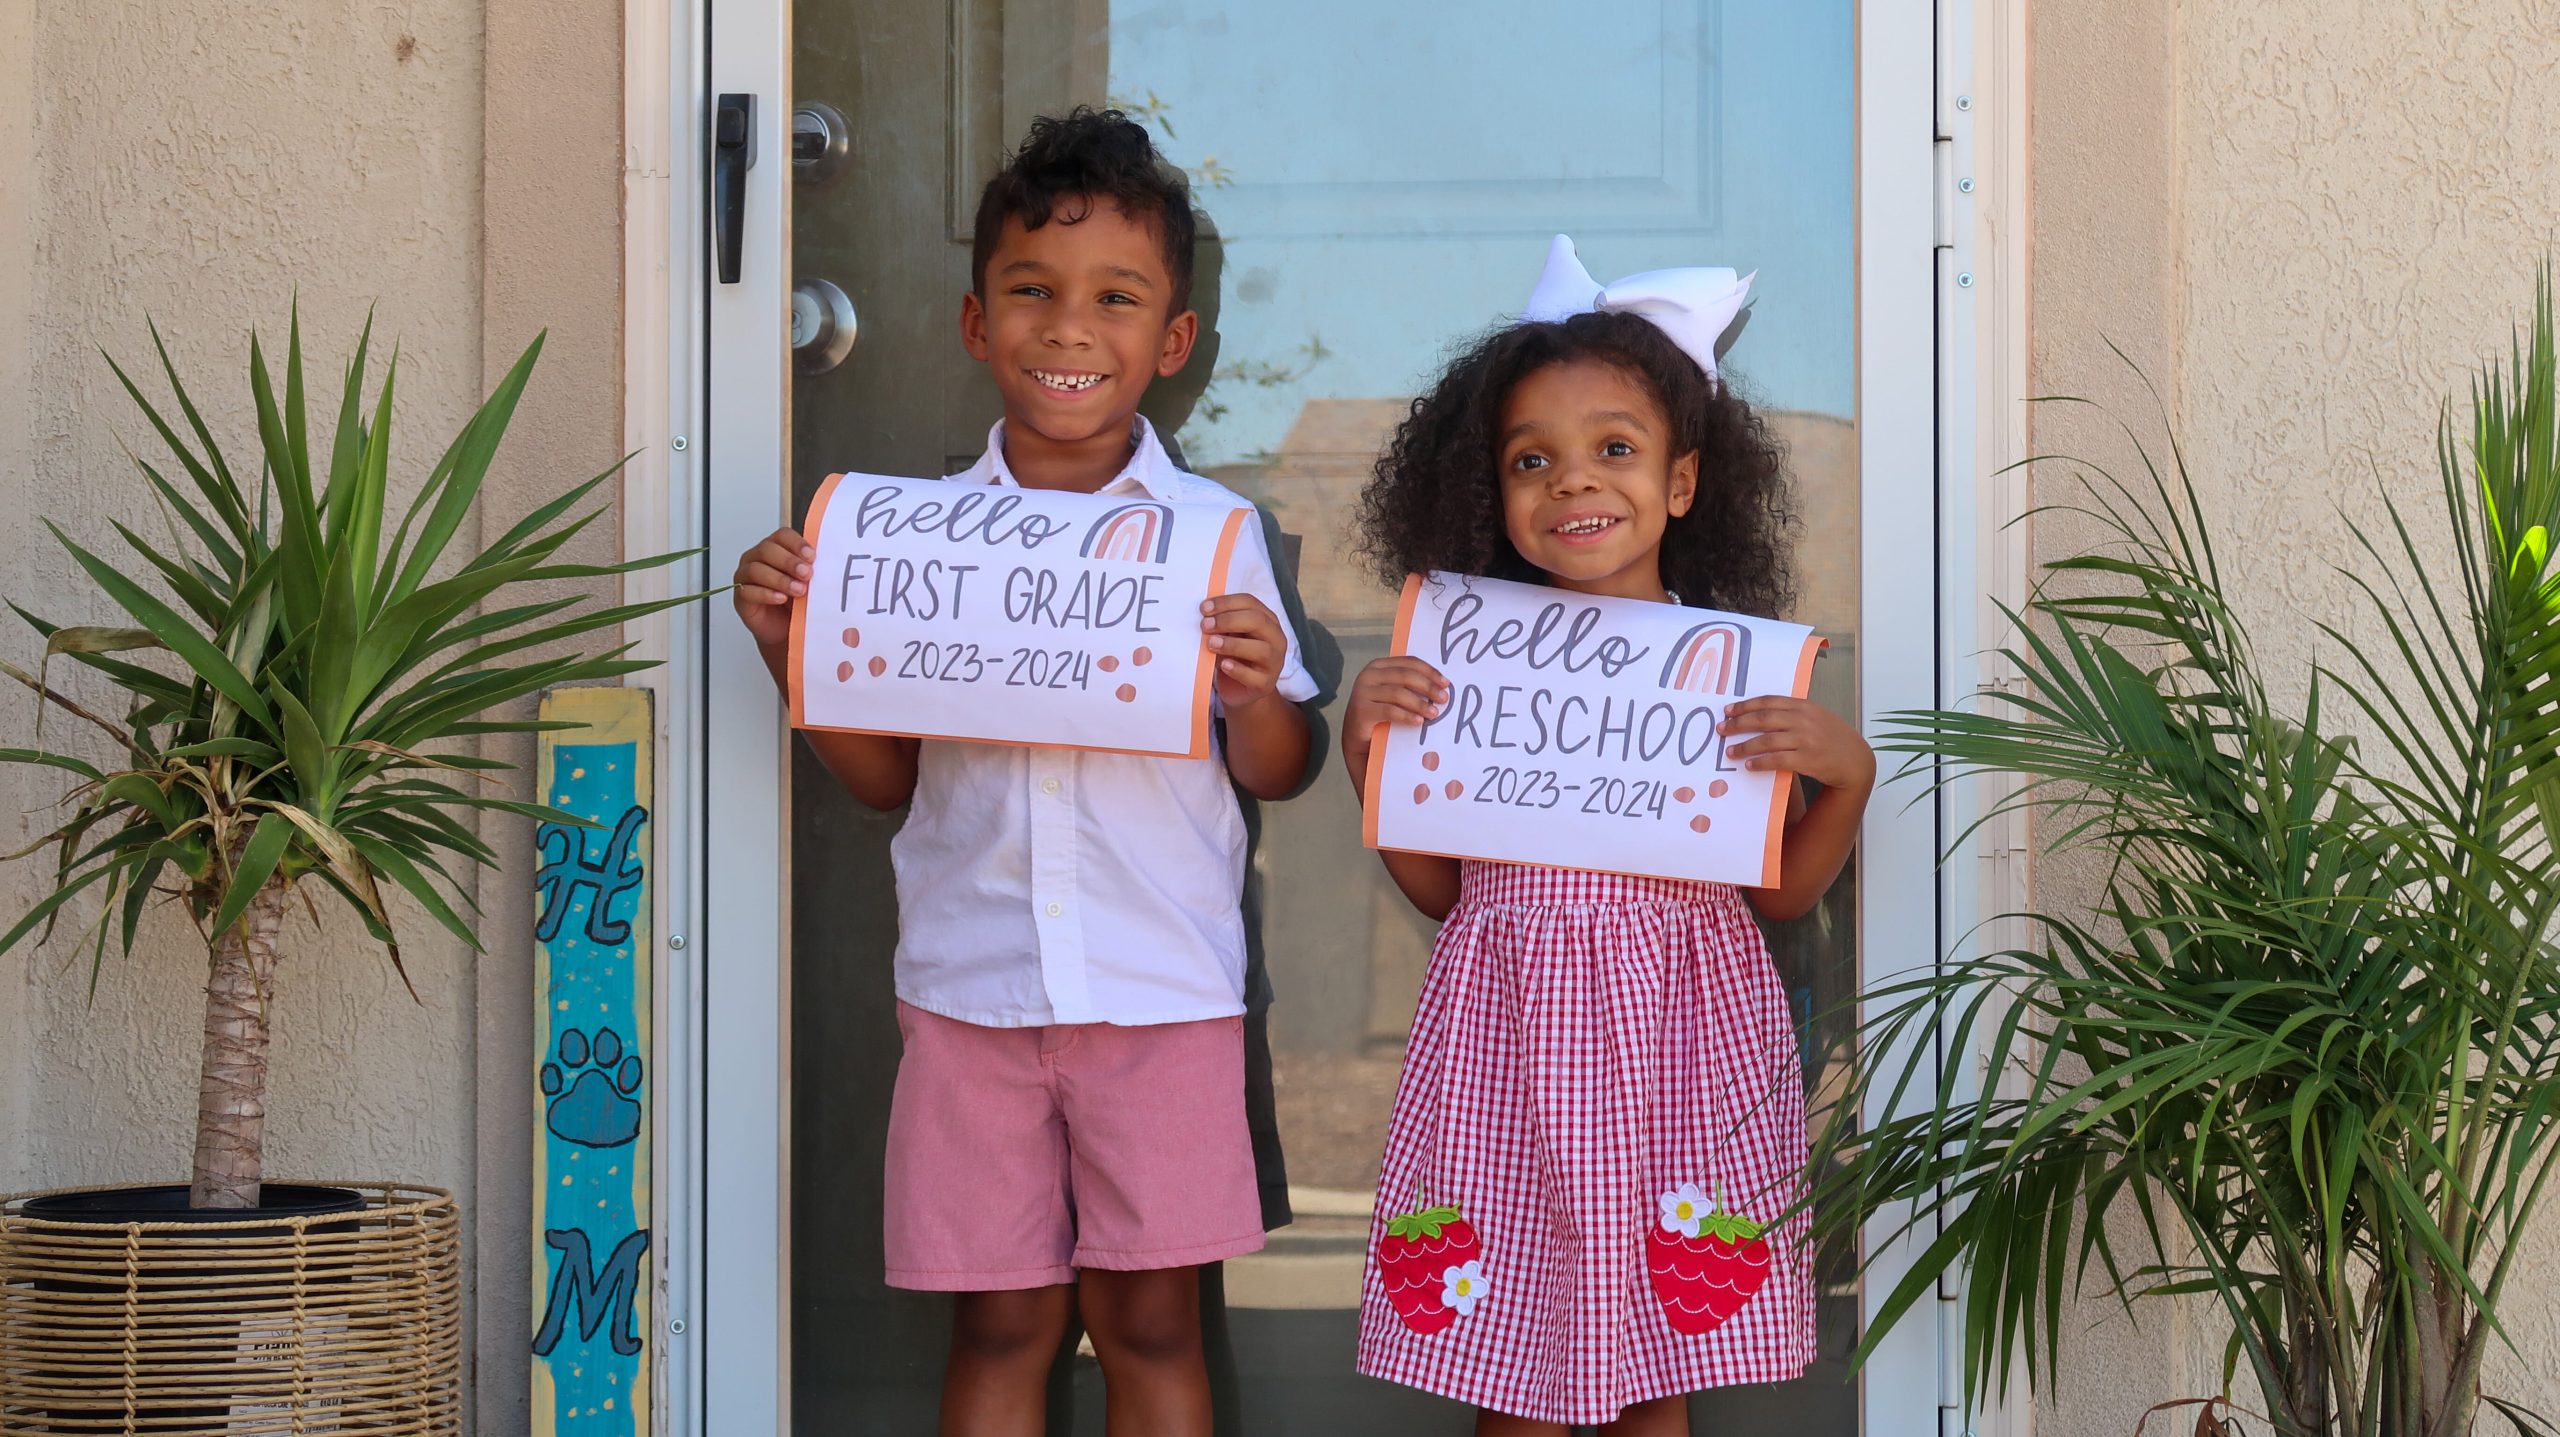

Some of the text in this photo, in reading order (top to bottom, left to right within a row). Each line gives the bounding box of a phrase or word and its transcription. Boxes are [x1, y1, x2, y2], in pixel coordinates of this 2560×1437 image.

[856, 485, 1071, 550] hello
[840, 553, 1165, 633] FIRST GRADE
[897, 640, 1092, 691] 2023-2024
[1440, 593, 1650, 679] hello
[1473, 765, 1668, 821] 2023-2024
